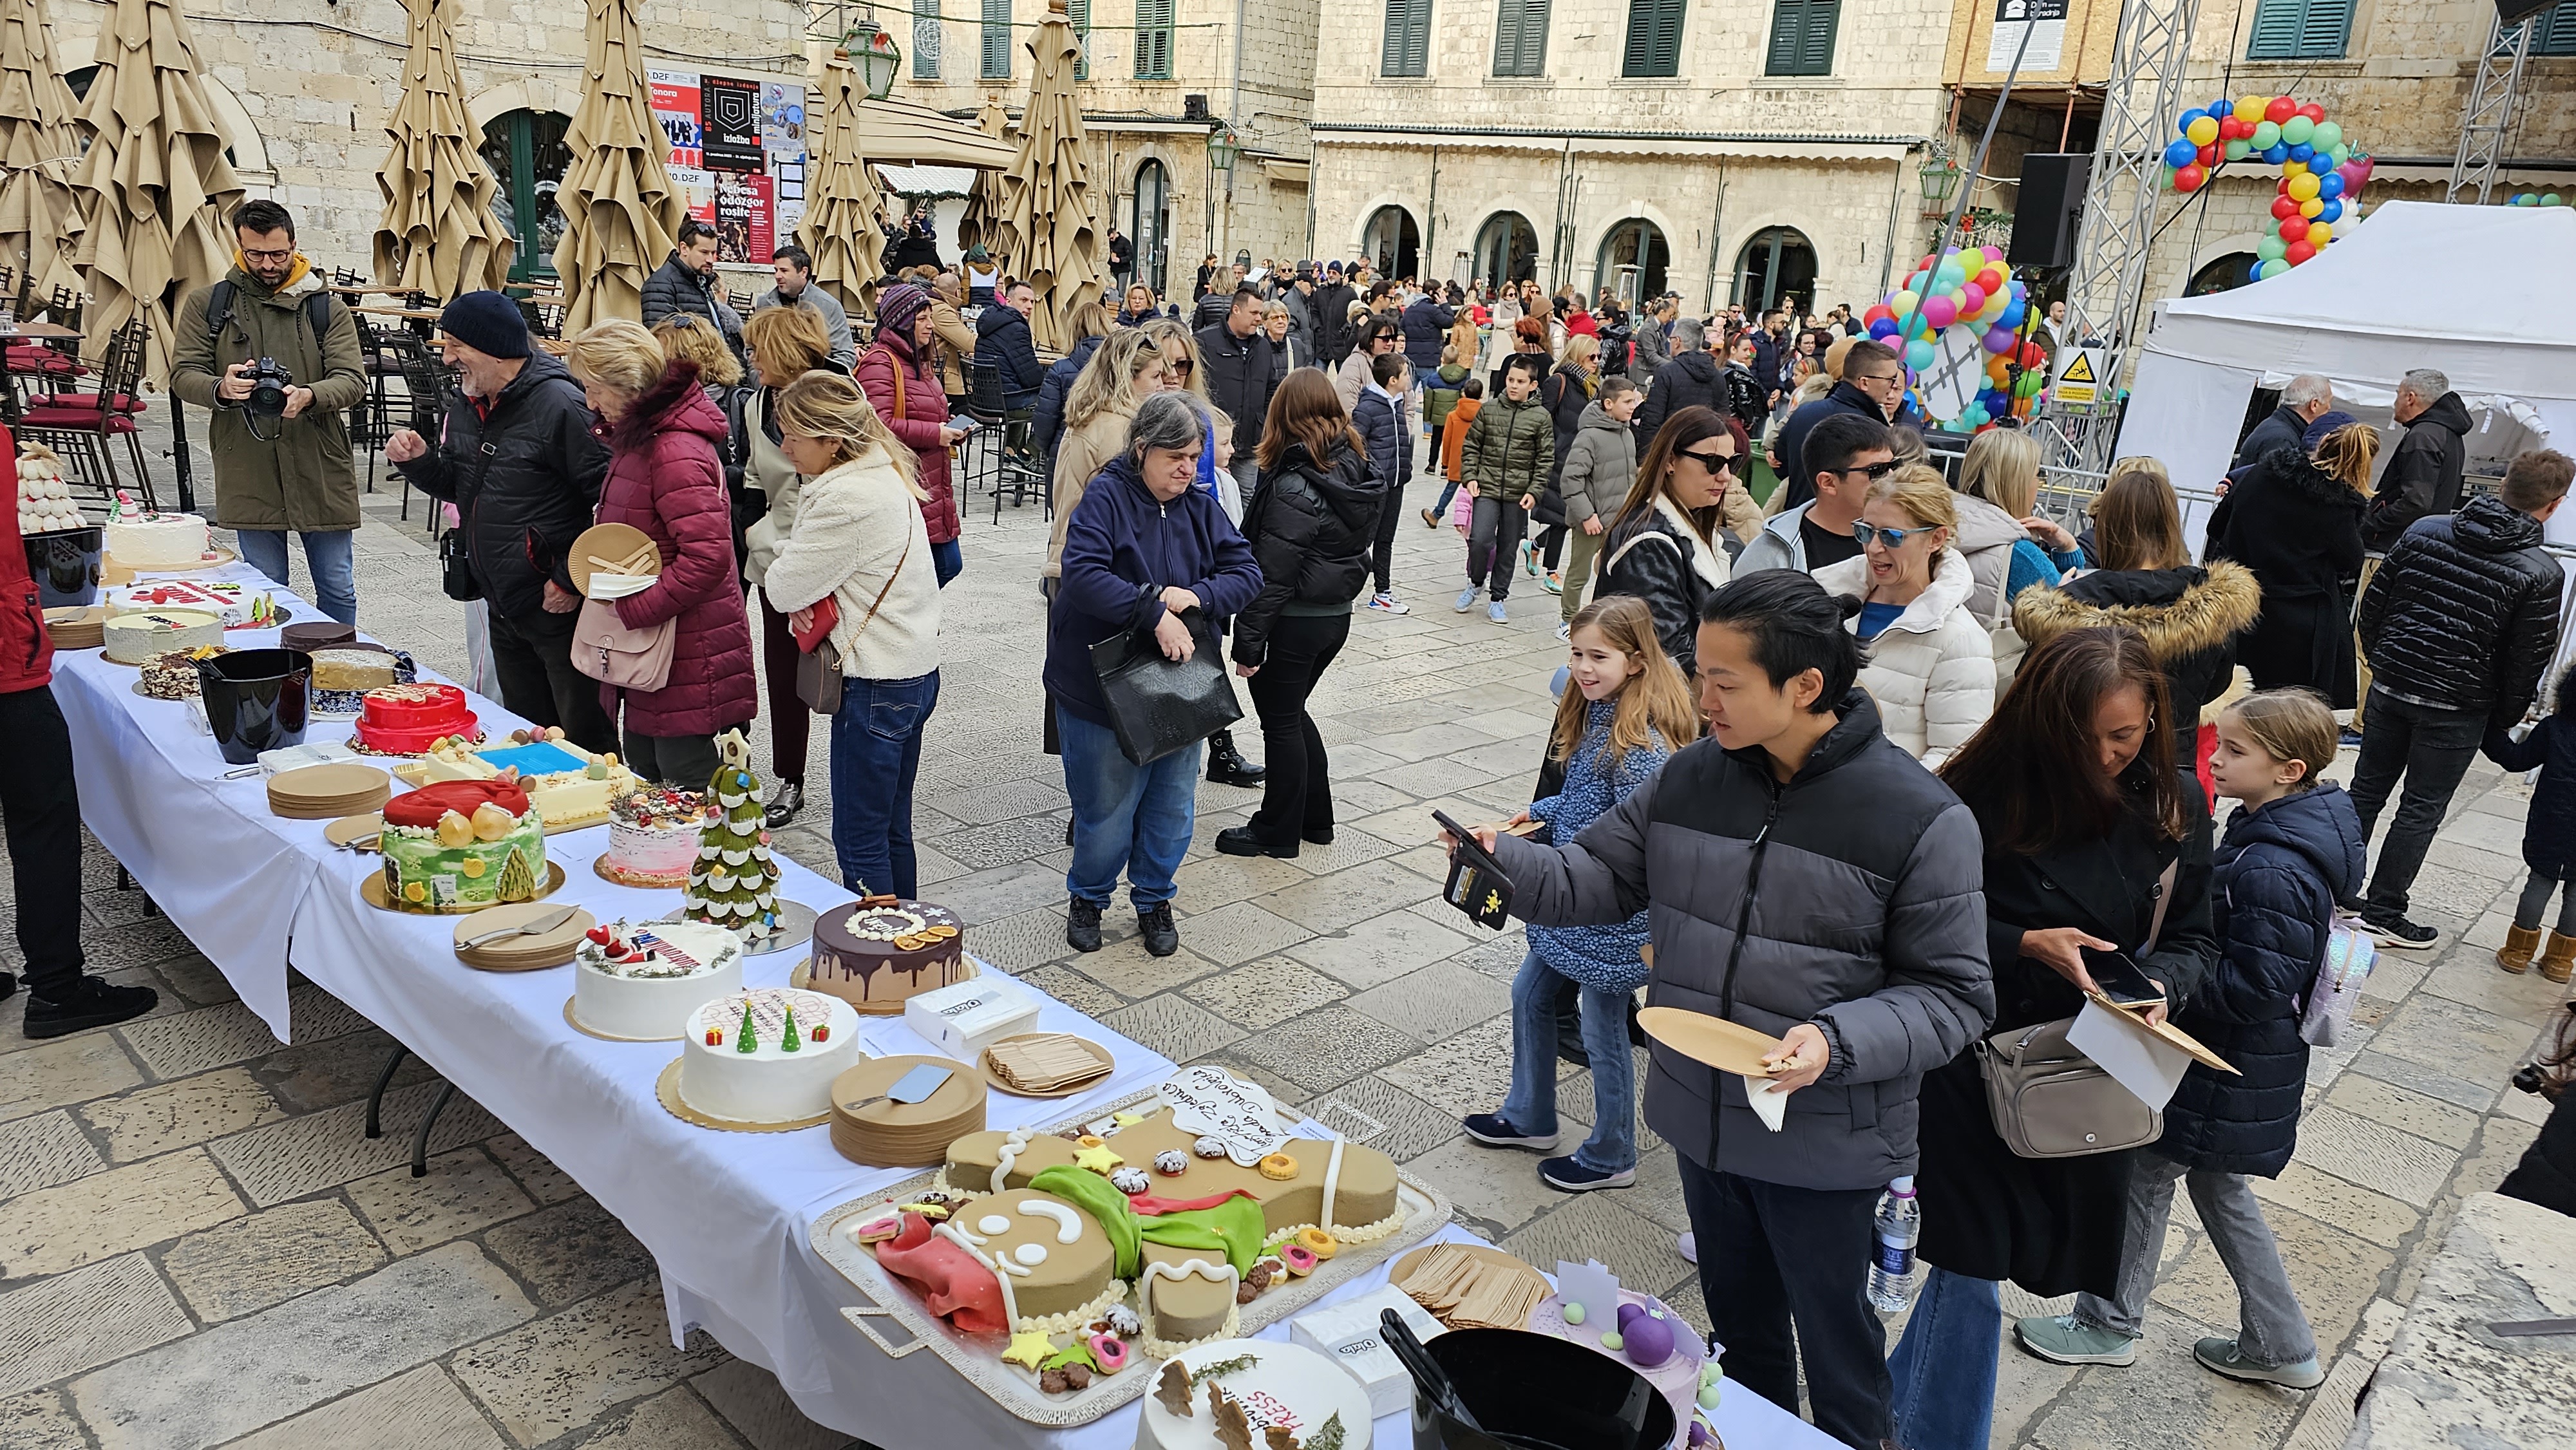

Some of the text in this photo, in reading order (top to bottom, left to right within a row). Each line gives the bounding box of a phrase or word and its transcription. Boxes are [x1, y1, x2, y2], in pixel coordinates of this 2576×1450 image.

[751, 92, 762, 134] minijatura
[723, 133, 750, 145] izložba
[719, 183, 758, 196] Nebesa
[719, 196, 764, 208] odozgor
[1247, 1391, 1304, 1433] PRESS
